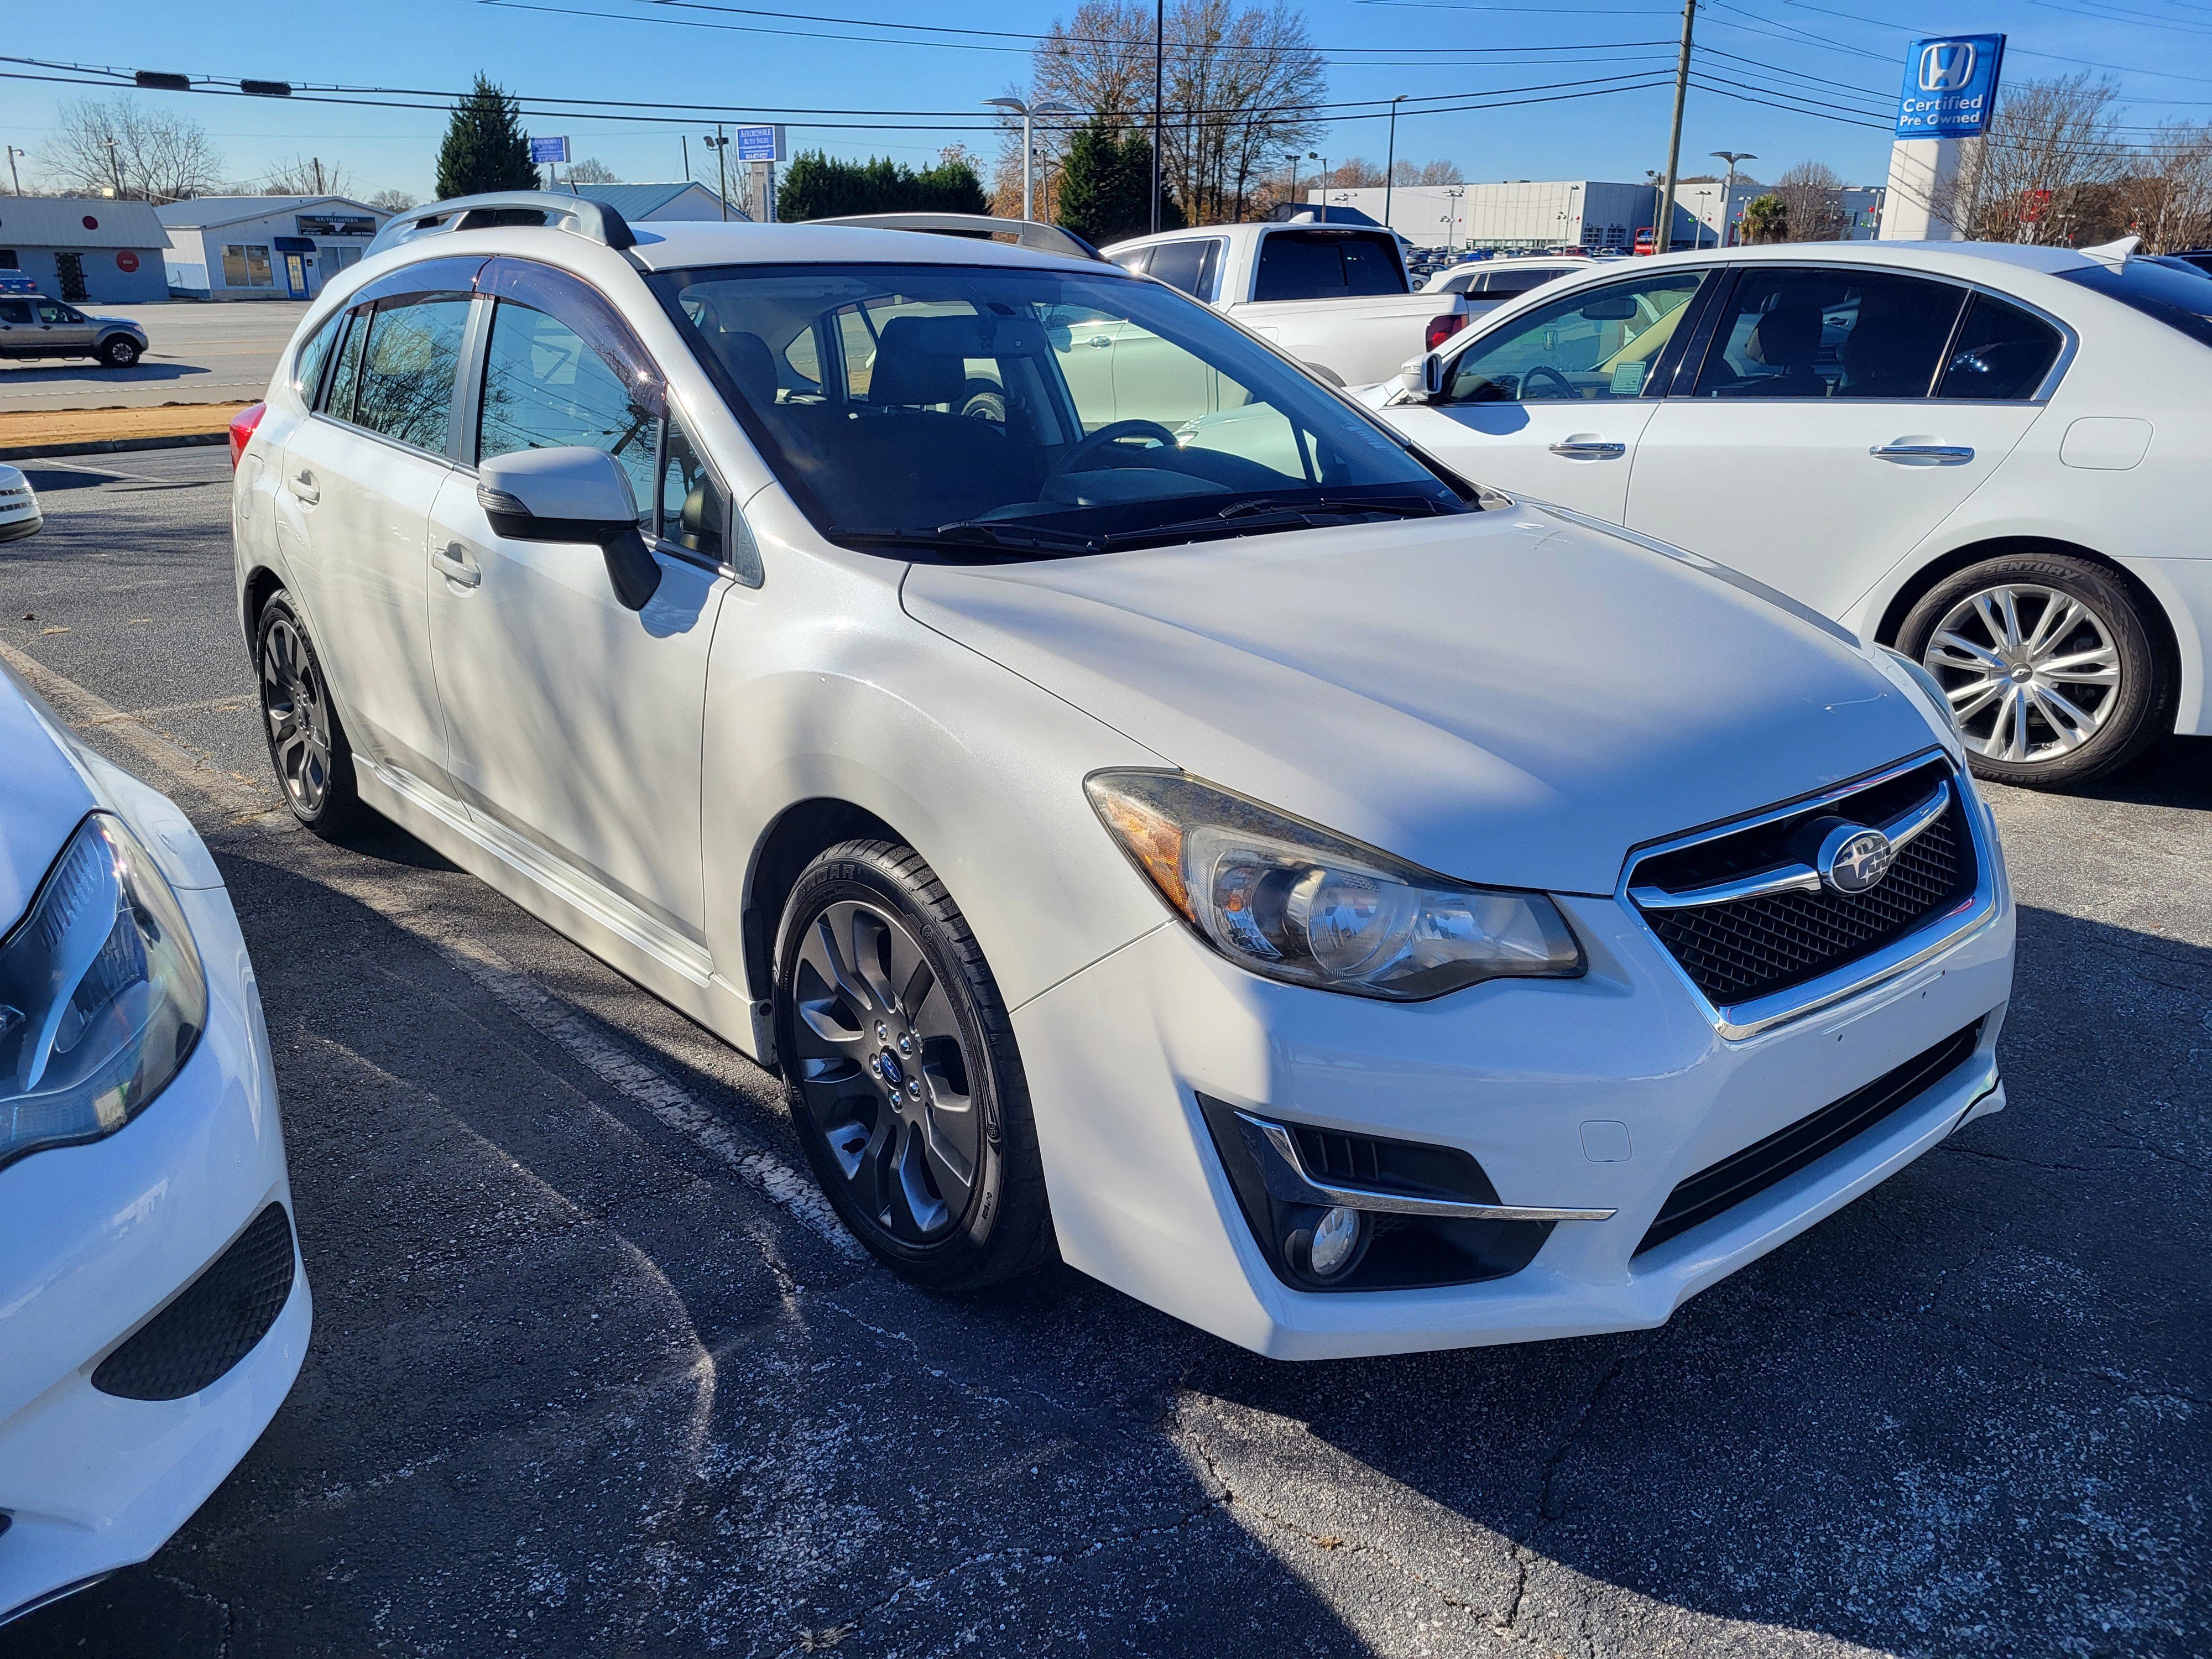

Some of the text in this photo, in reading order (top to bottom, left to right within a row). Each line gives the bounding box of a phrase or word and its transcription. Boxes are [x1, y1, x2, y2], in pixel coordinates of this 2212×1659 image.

[1903, 95, 1983, 112] Certified
[1984, 561, 2080, 581] SENTURY
[1971, 767, 2052, 784] SENTUR
